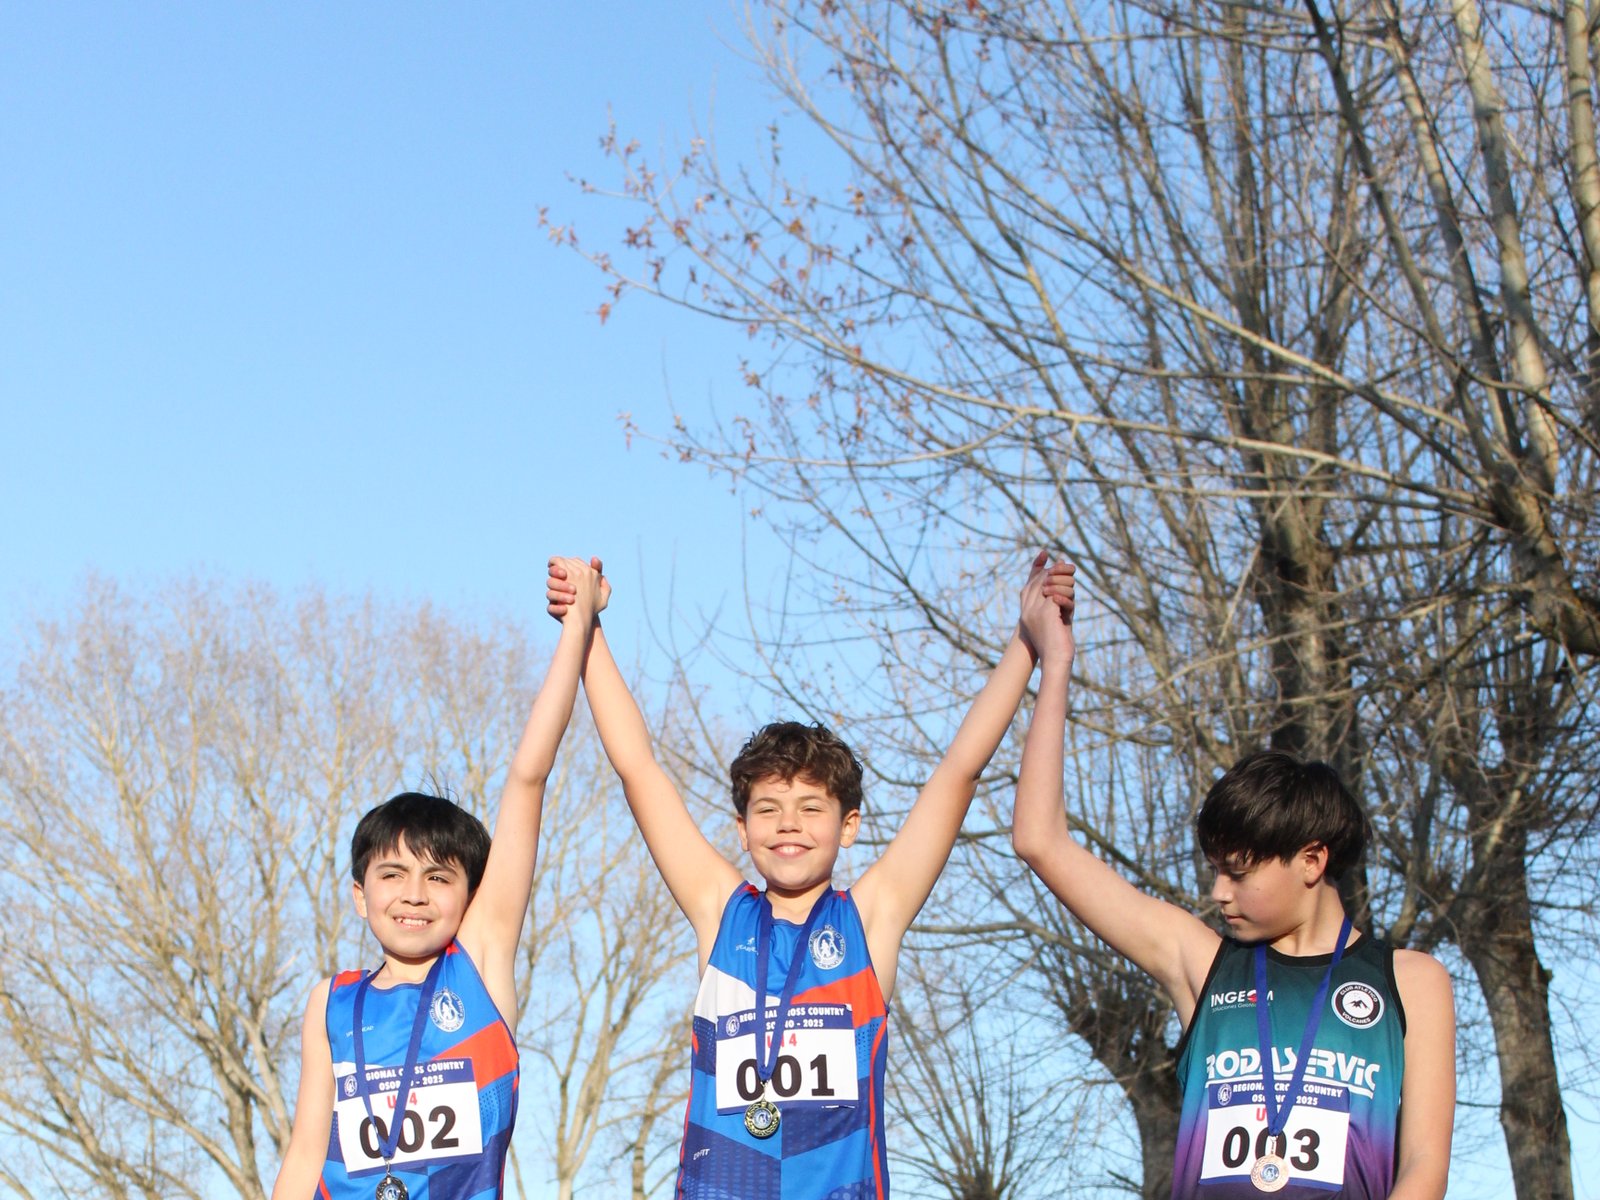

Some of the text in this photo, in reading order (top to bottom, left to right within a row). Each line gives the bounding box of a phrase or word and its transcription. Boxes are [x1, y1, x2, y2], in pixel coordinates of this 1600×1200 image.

[1340, 985, 1354, 996] CLUB
[739, 1009, 777, 1022] REGINAL
[808, 1006, 845, 1017] COUNTRY
[1342, 1011, 1371, 1024] VOLCANES
[803, 1019, 824, 1028] 2025
[398, 1065, 425, 1077] CSS
[427, 1060, 465, 1073] COUNTRY
[378, 1079, 414, 1091] OSOR
[422, 1074, 444, 1086] 2025
[736, 1053, 835, 1101] 001
[1233, 1082, 1265, 1092] REGION
[1303, 1083, 1343, 1098] COUNTRY
[386, 1091, 418, 1110] U4
[1296, 1095, 1319, 1106] 2025
[359, 1105, 460, 1160] 002
[1222, 1126, 1321, 1172] 003
